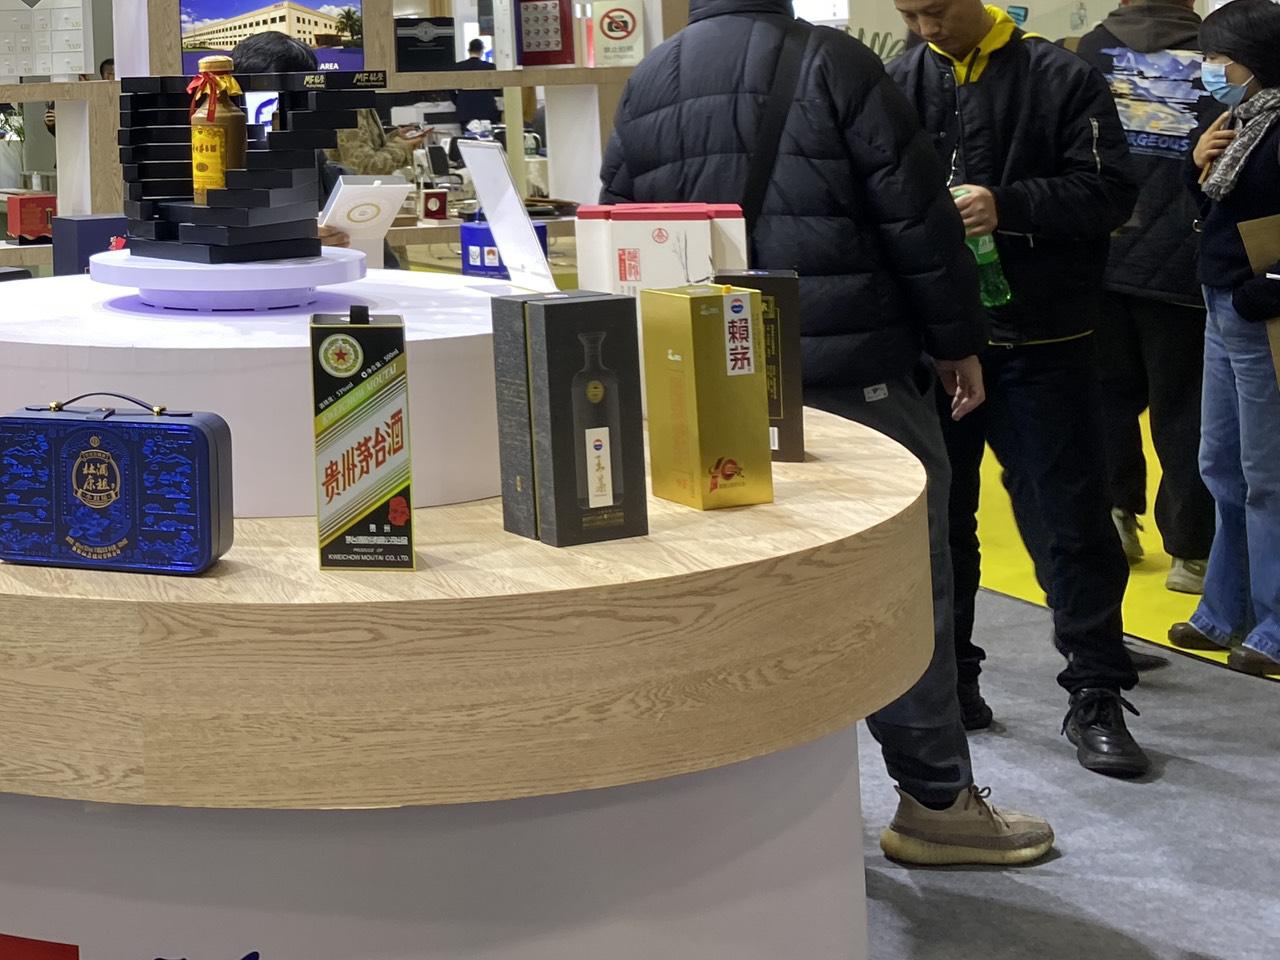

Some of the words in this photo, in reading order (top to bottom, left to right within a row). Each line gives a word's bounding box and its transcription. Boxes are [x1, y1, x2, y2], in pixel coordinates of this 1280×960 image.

[320, 62, 340, 70] AREA
[322, 407, 404, 505] 贵州茅台酒
[328, 553, 361, 561] KWEICHOW
[361, 554, 385, 562] MOUTAI
